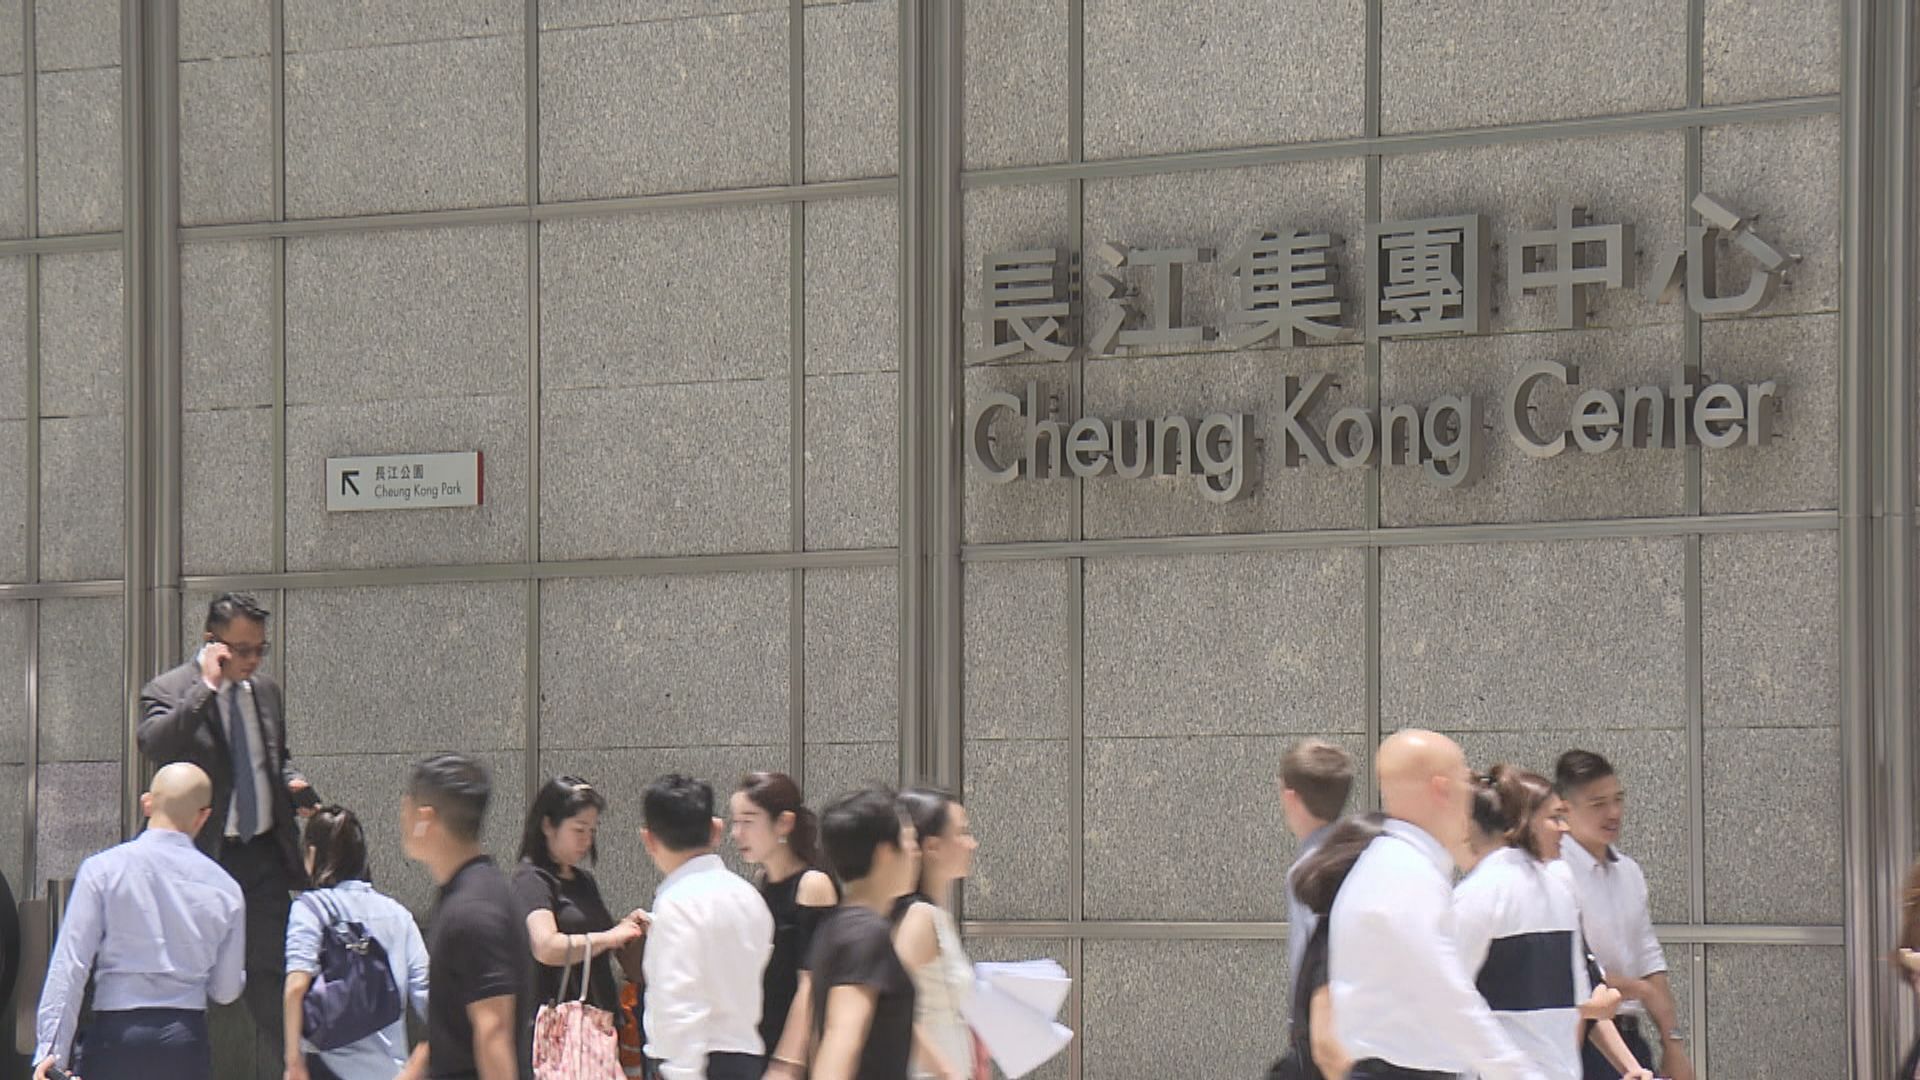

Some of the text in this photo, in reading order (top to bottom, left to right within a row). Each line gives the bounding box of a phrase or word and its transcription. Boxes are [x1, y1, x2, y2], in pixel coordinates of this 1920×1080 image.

[963, 192, 1786, 366] 長江集團中心
[967, 359, 1777, 503] Cheung Kong Center
[374, 481, 462, 500] Cheung Kong Park
[375, 464, 424, 481] 長江公園
